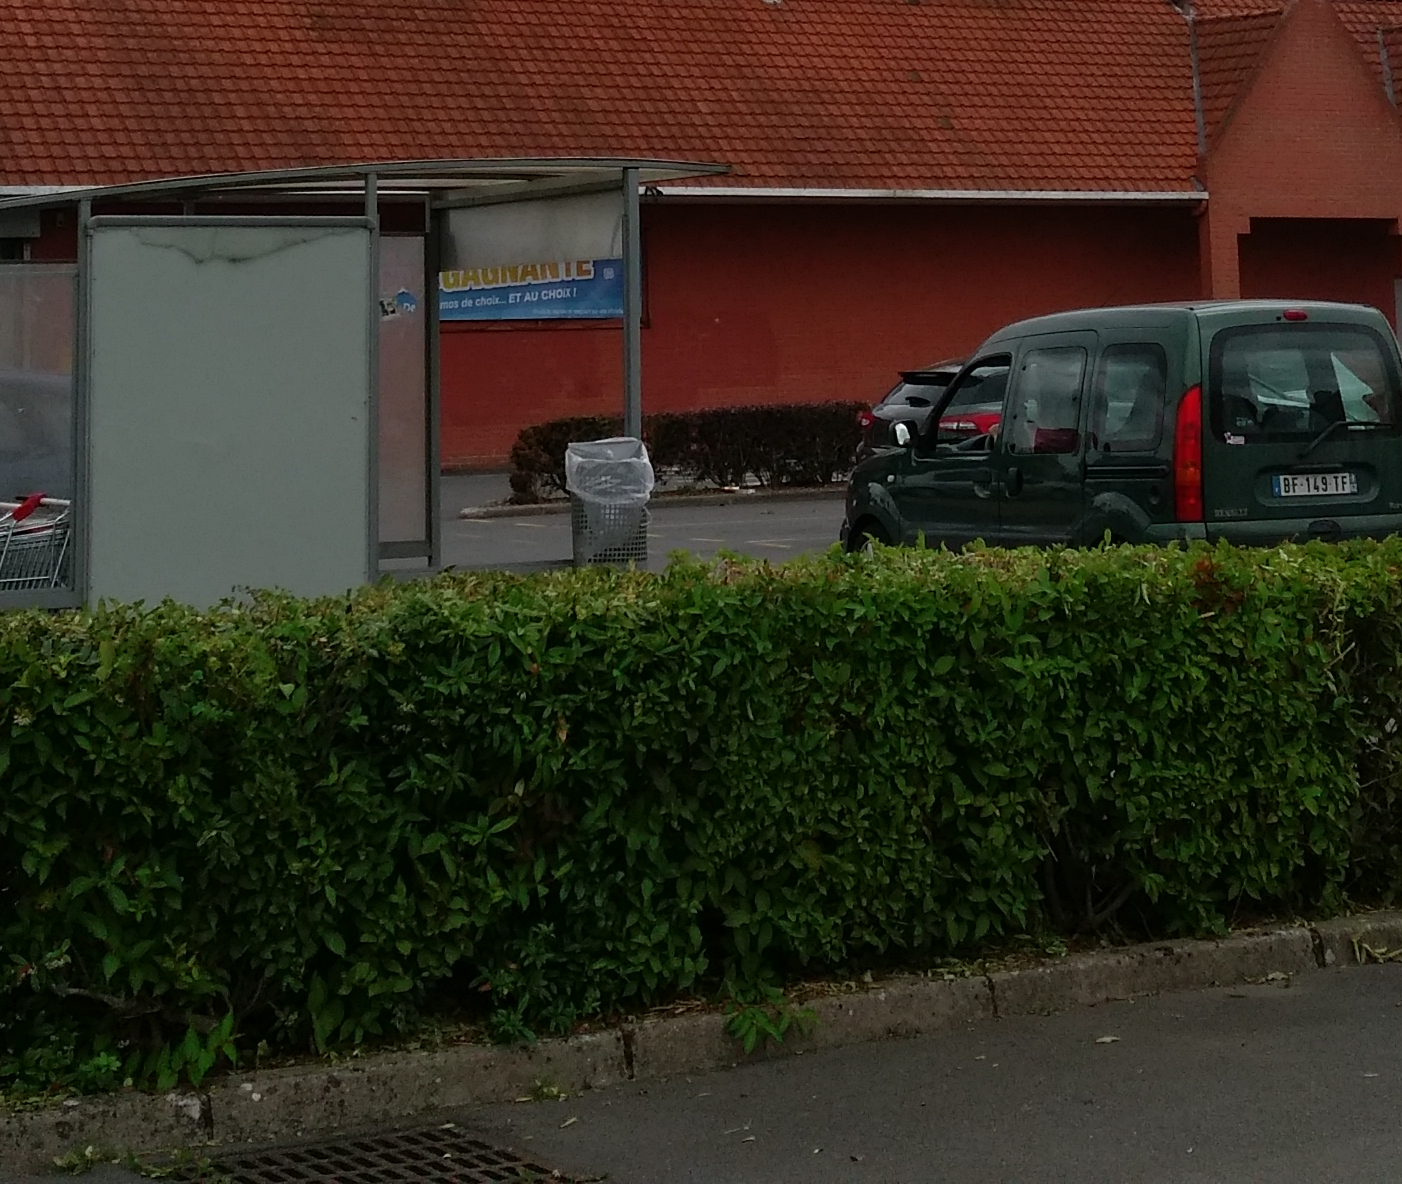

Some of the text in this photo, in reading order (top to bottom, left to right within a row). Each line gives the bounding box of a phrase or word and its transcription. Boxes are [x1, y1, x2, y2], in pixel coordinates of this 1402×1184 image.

[461, 297, 473, 308] de
[508, 293, 521, 304] ET
[524, 291, 538, 303] AU
[541, 288, 571, 301] CHOIX
